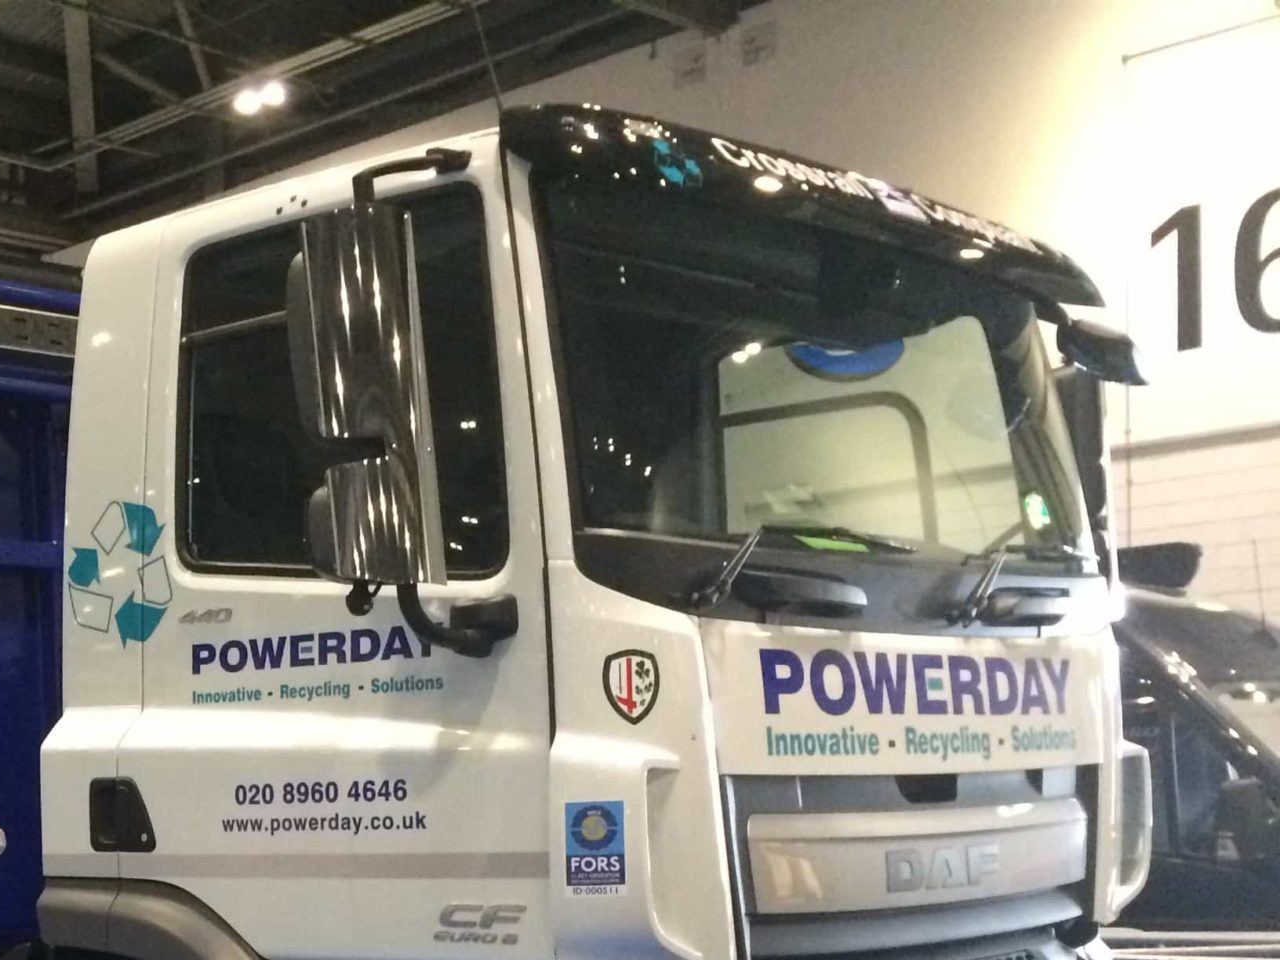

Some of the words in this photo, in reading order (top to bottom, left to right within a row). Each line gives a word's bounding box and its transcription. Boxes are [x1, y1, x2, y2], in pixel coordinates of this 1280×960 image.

[711, 137, 874, 200] Crossrail
[1151, 187, 1280, 351] 16
[178, 608, 232, 624] 440
[192, 687, 261, 704] Innovative
[280, 681, 351, 701] Recycling
[371, 675, 444, 694] Solutions
[759, 648, 1070, 715] POWERDAY
[766, 725, 880, 756] Innovative
[904, 726, 991, 761] Recycling
[1011, 724, 1077, 753] Solutions
[235, 783, 274, 805] 020
[282, 782, 338, 804] 8960
[347, 779, 407, 802] 4646
[222, 811, 427, 836] www.powerday.co.uk
[571, 856, 620, 873] FORS
[885, 845, 999, 893] DAF
[439, 904, 527, 929] CF
